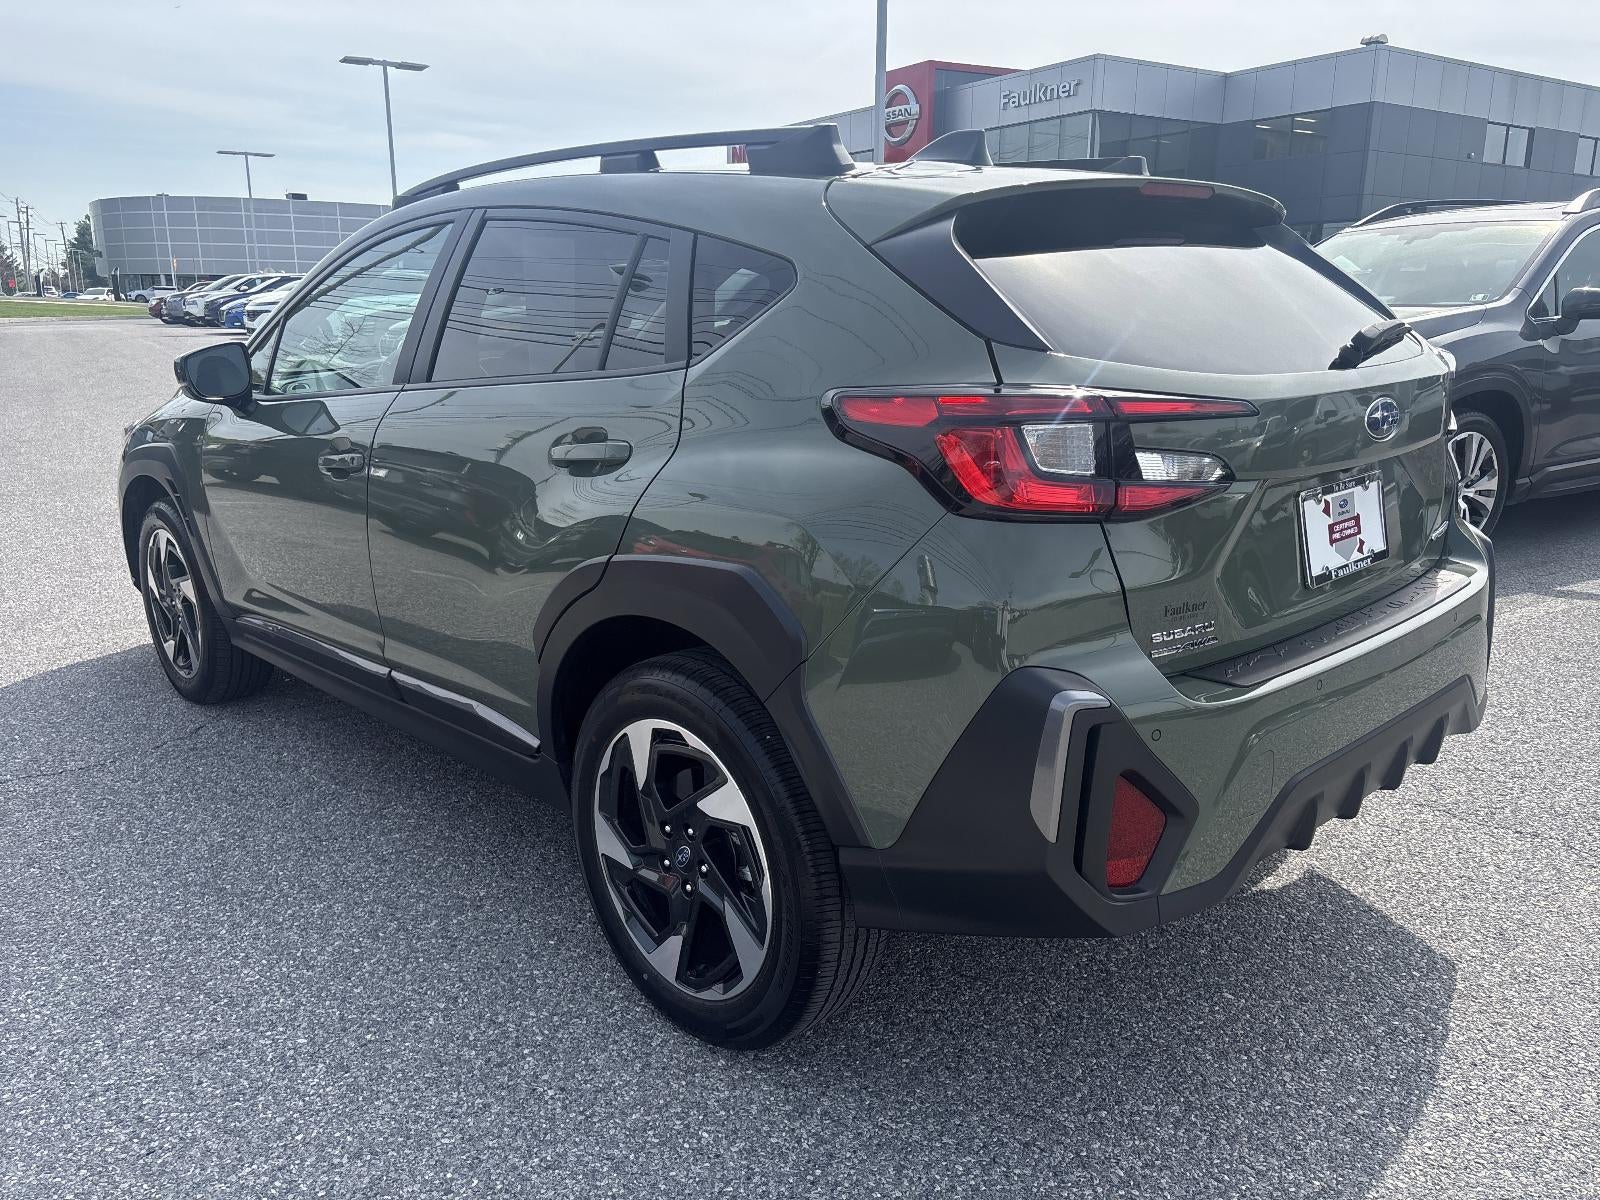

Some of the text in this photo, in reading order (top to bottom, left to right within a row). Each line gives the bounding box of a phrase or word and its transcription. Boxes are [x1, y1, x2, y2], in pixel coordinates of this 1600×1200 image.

[1000, 80, 1080, 110] Faulkner
[885, 107, 912, 121] SSAN
[1332, 526, 1358, 540] PRE-OWNED
[1333, 520, 1356, 532] CERTIFIED
[1331, 558, 1373, 580] Faulkner
[1163, 600, 1207, 617] Faulkner
[1151, 620, 1215, 643] SUBARU
